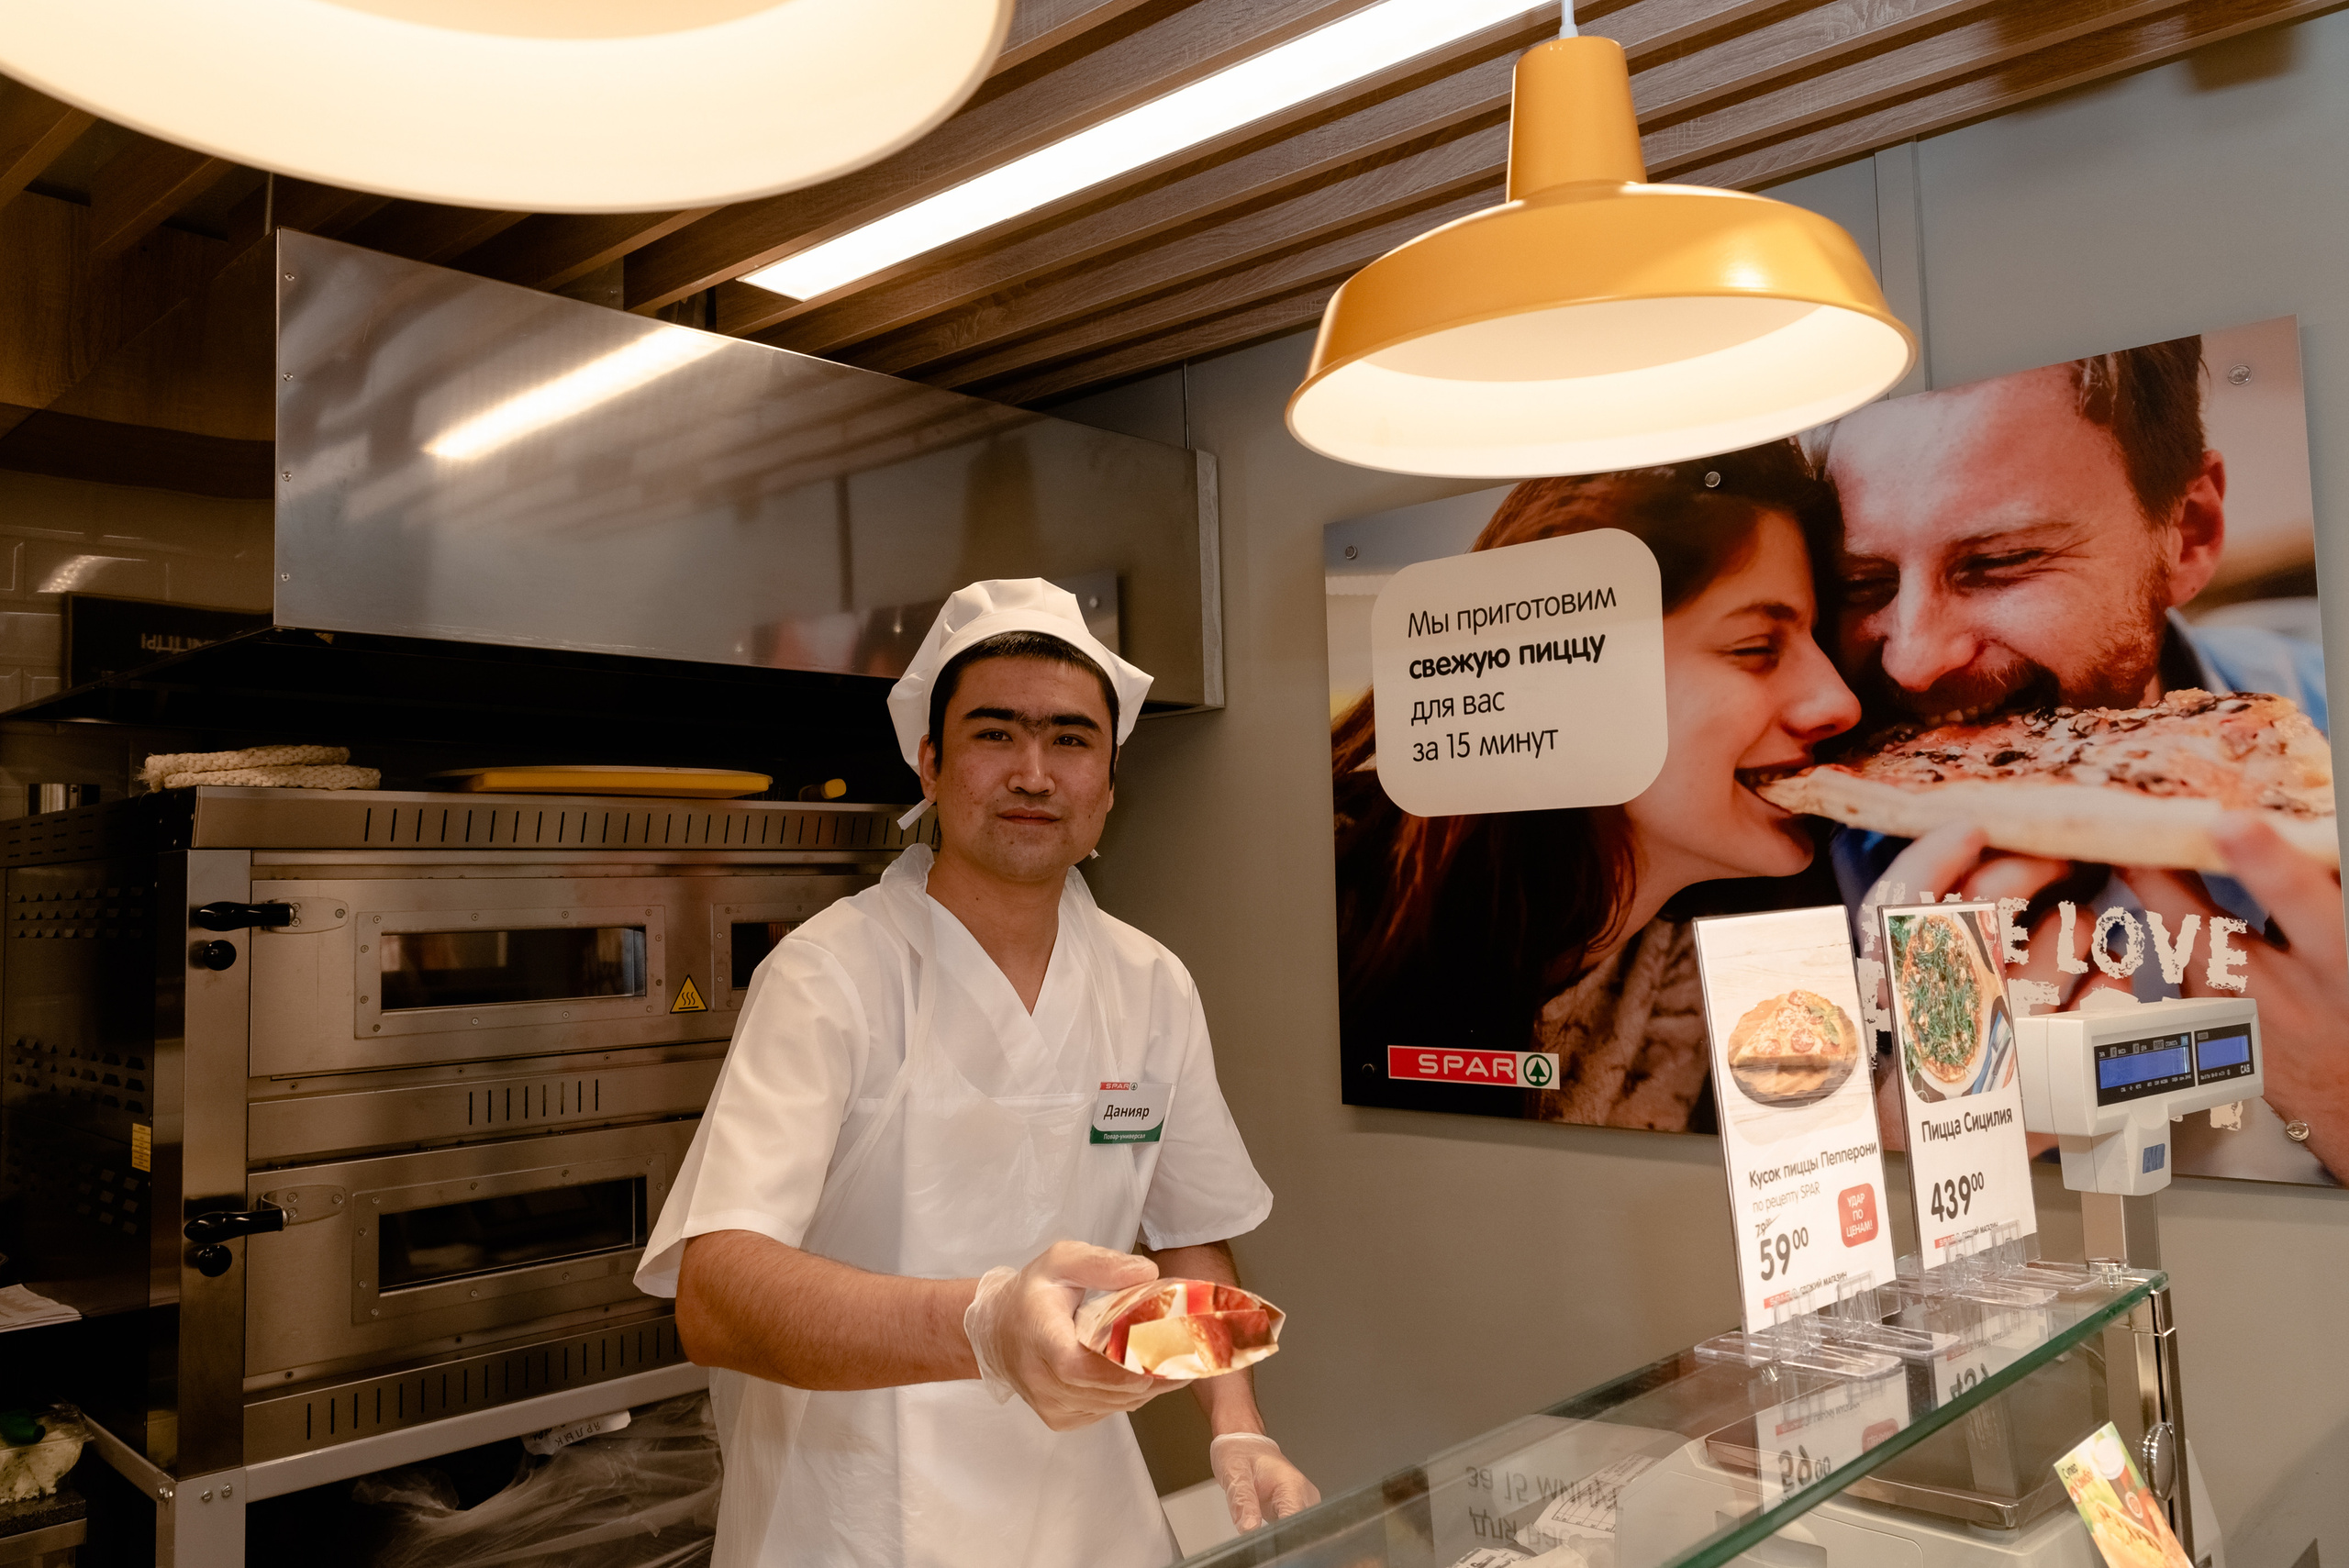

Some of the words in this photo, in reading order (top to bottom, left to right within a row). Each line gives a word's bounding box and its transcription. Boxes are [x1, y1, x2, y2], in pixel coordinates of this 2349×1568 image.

[1407, 609, 1450, 639] Мы
[1457, 586, 1617, 635] приготовим
[1408, 643, 1511, 679] свежую
[1520, 633, 1607, 665] пиццу
[1410, 695, 1454, 726] для
[1463, 691, 1506, 717] вас
[1412, 740, 1439, 762] за
[1446, 730, 1471, 760] 15
[1479, 727, 1559, 760] минут
[2058, 899, 2248, 994] LOVE
[1418, 1053, 1515, 1080] SPAR
[2240, 1063, 2251, 1074] CAS
[1103, 1104, 1150, 1121] Данияр
[1920, 1118, 1962, 1143] Пицца
[1964, 1107, 2013, 1133] Сицилия
[1749, 1164, 1782, 1190] Кусок
[1784, 1157, 1820, 1179] пиццы
[1820, 1141, 1878, 1168] Пепперони
[1753, 1200, 1764, 1213] по
[1765, 1190, 1799, 1214] рецепту
[1800, 1181, 1820, 1199] SPAR
[1847, 1193, 1865, 1208] УДАР
[1845, 1219, 1874, 1238] ЦЕНАМ!
[1852, 1208, 1865, 1222] ПО
[554, 1421, 601, 1447] ЯРЛЫК
